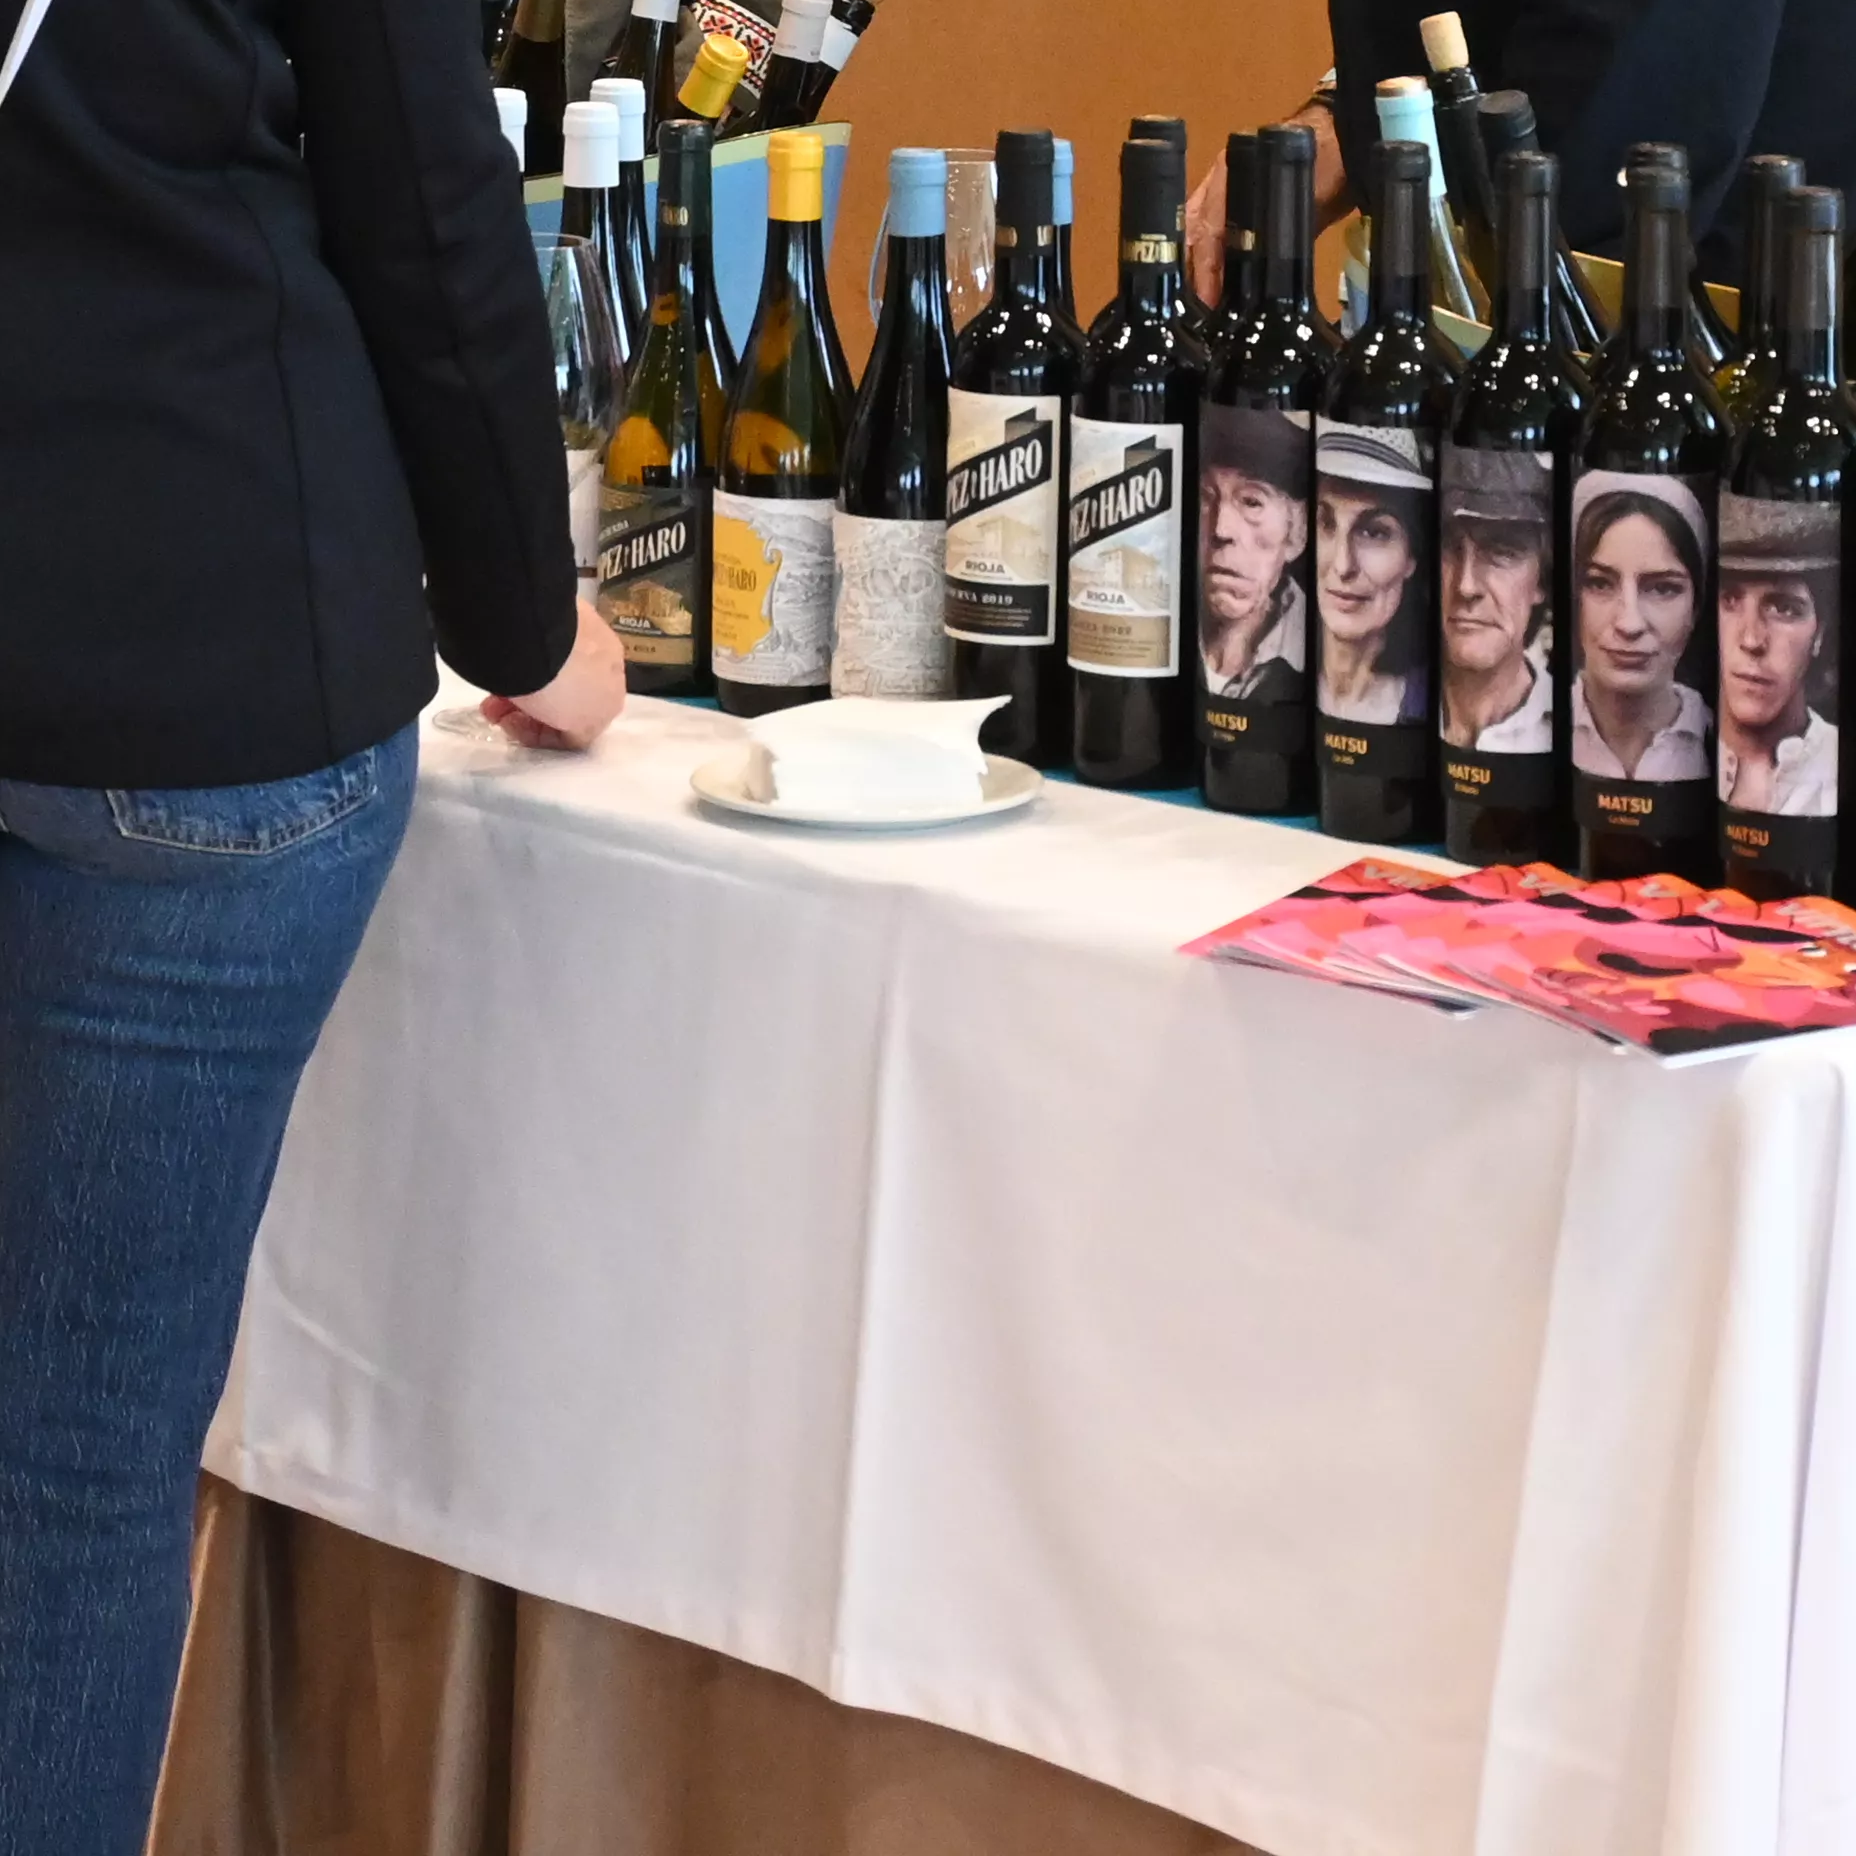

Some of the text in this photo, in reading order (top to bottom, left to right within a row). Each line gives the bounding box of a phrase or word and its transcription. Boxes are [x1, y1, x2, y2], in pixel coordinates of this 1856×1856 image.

[980, 438, 1043, 501] HARO
[1069, 497, 1090, 544] EZ
[1100, 467, 1163, 530] HARO
[631, 521, 686, 569] HARO
[965, 560, 1006, 574] RIOJA
[1086, 590, 1126, 604] RIOJA
[619, 616, 651, 629] RIOJA
[1206, 709, 1248, 732] MATSU
[1324, 732, 1368, 755] MATSU
[1448, 763, 1491, 784] MATSU
[1597, 794, 1653, 814] MATSU
[1726, 824, 1770, 847] MATSU
